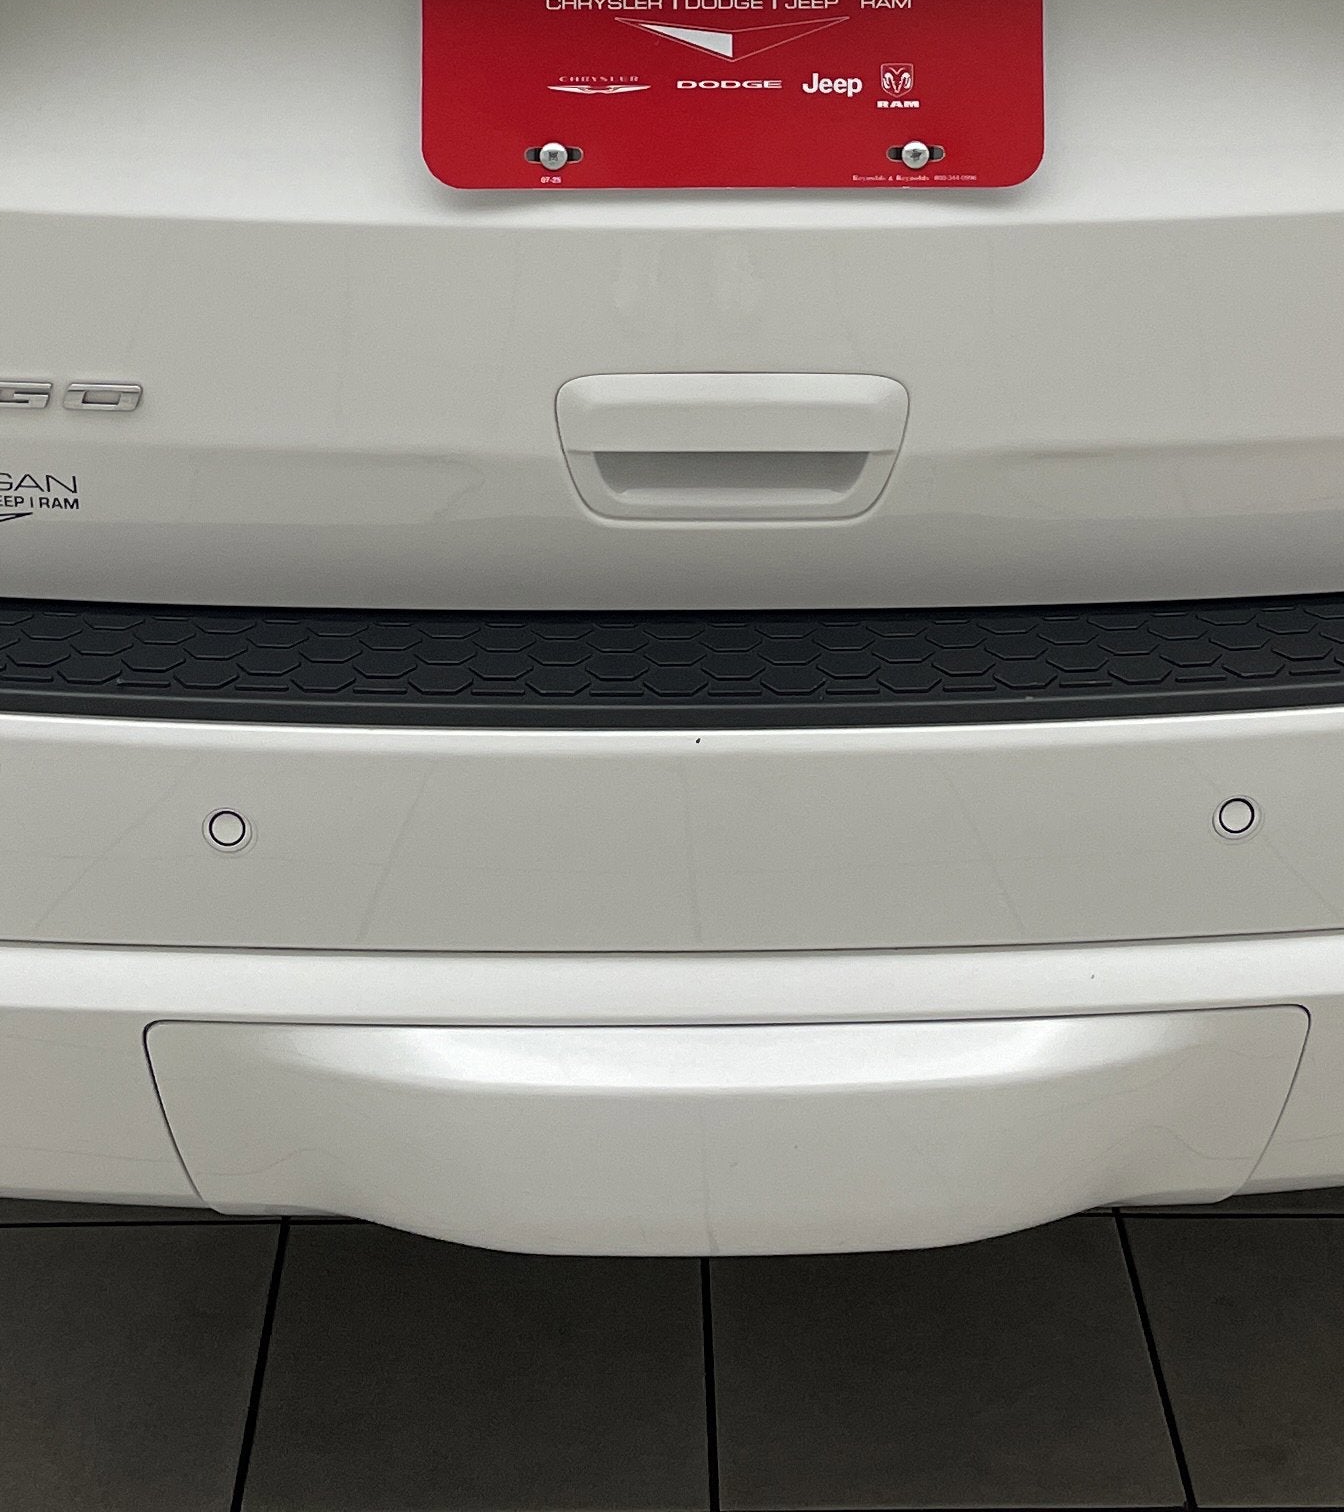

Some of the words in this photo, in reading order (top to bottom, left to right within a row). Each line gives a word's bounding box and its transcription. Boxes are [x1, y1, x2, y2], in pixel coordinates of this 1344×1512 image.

[676, 80, 783, 89] DODGE
[802, 72, 863, 97] Jeep
[876, 100, 920, 108] RAM
[38, 497, 80, 510] RAM
